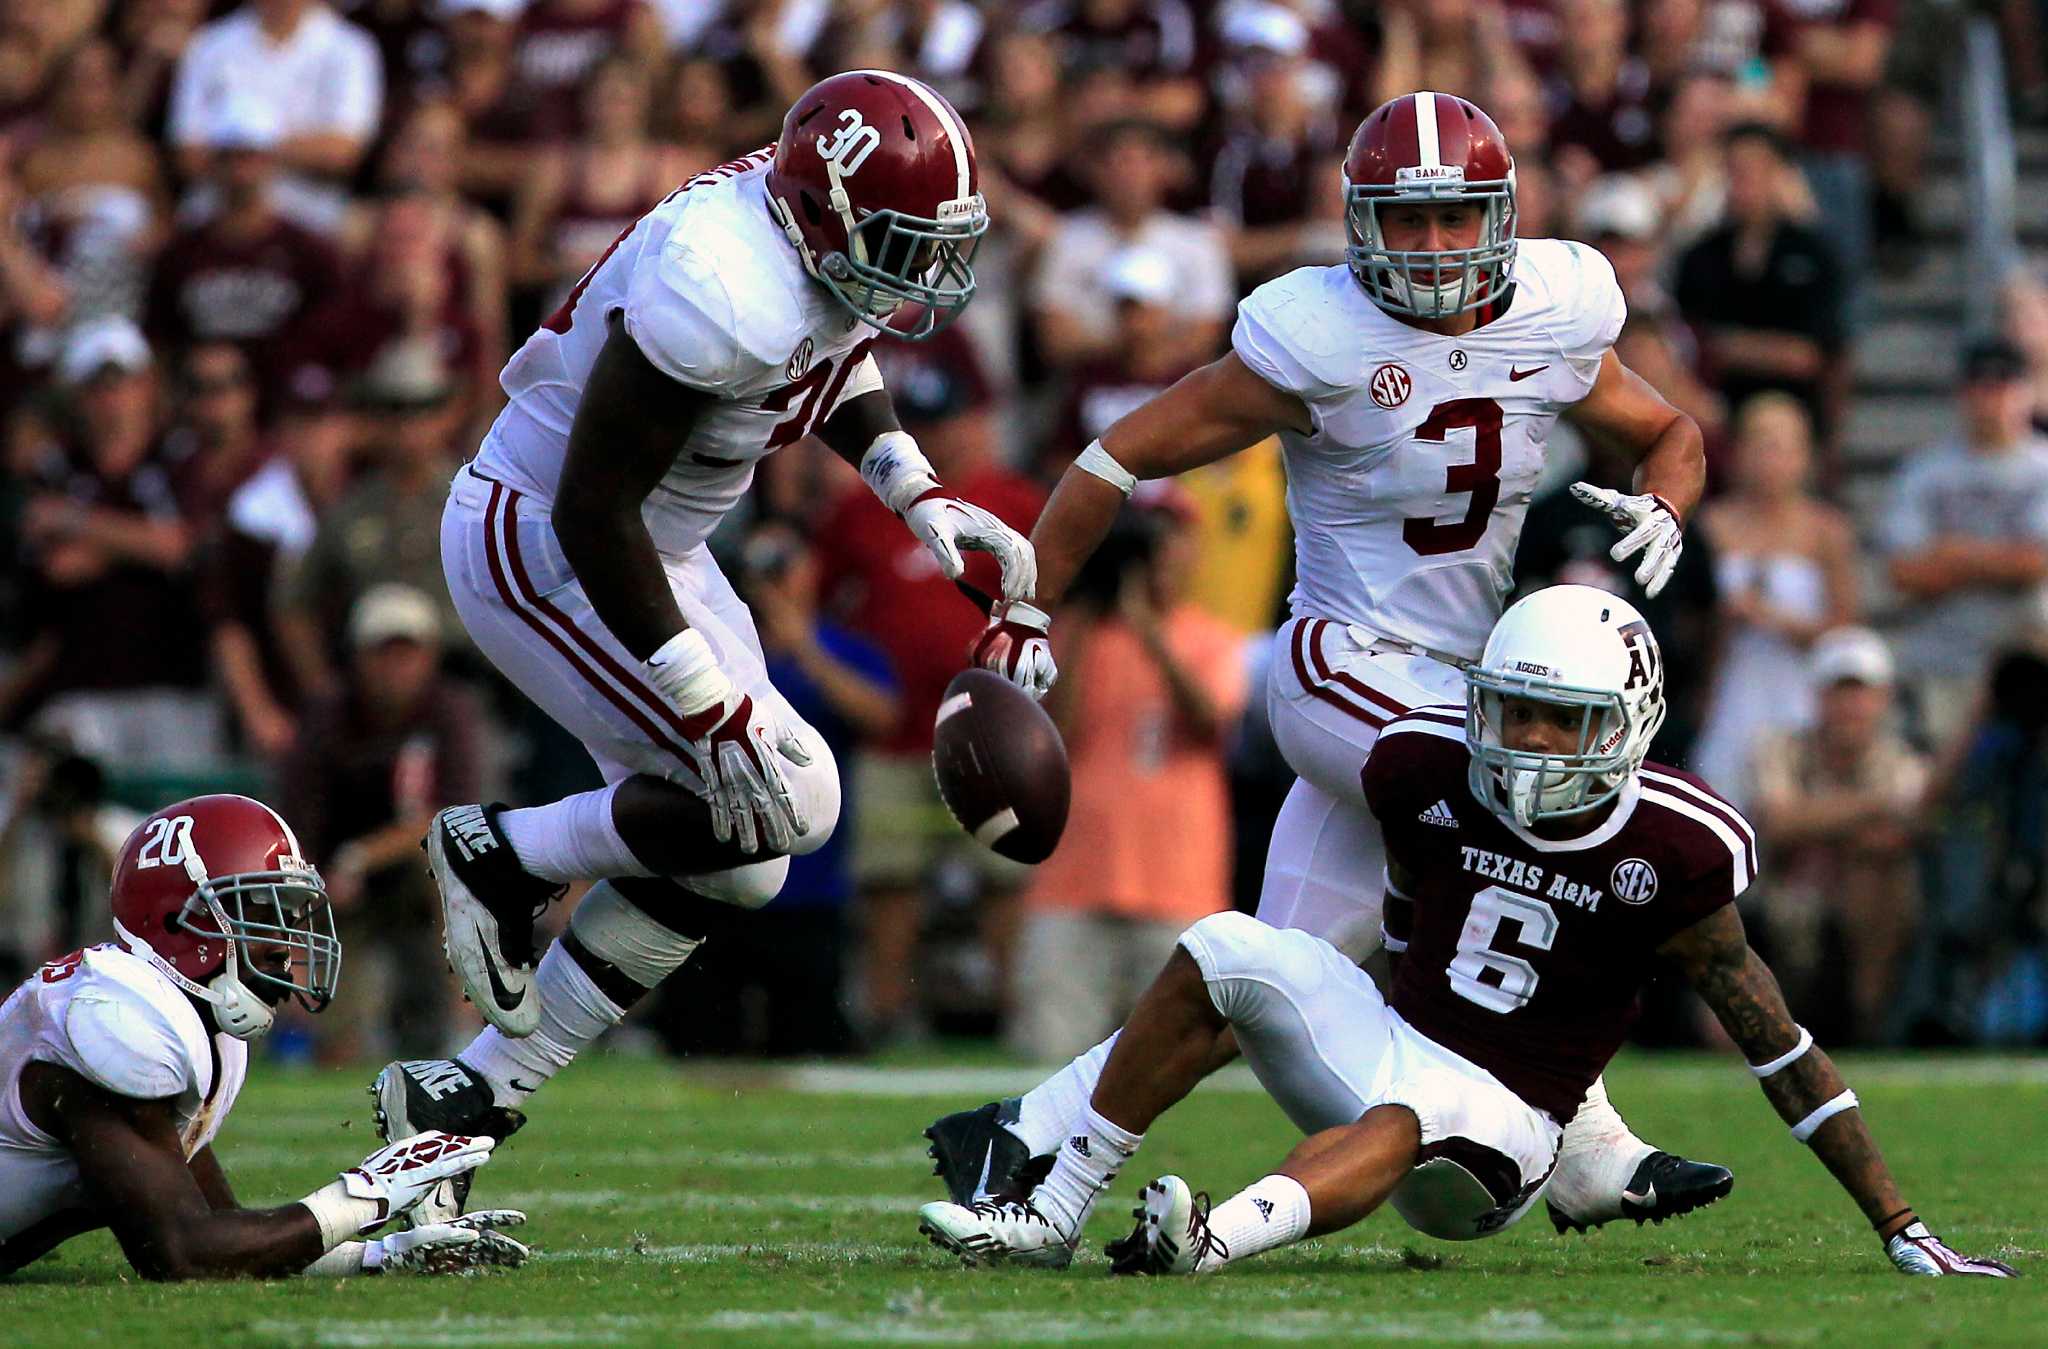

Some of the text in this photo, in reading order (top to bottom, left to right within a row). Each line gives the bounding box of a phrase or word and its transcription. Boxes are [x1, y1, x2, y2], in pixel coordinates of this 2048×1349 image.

[816, 109, 880, 176] 30
[1415, 168, 1447, 178] BAMA
[1371, 365, 1410, 406] SEC
[1403, 397, 1504, 556] 3
[1515, 661, 1549, 677] AGGIES
[137, 815, 194, 869] 20
[1418, 813, 1459, 829] adidas
[1461, 846, 1603, 913] TEXAS A&M
[1615, 862, 1654, 901] SEC
[1445, 885, 1560, 1014] 6
